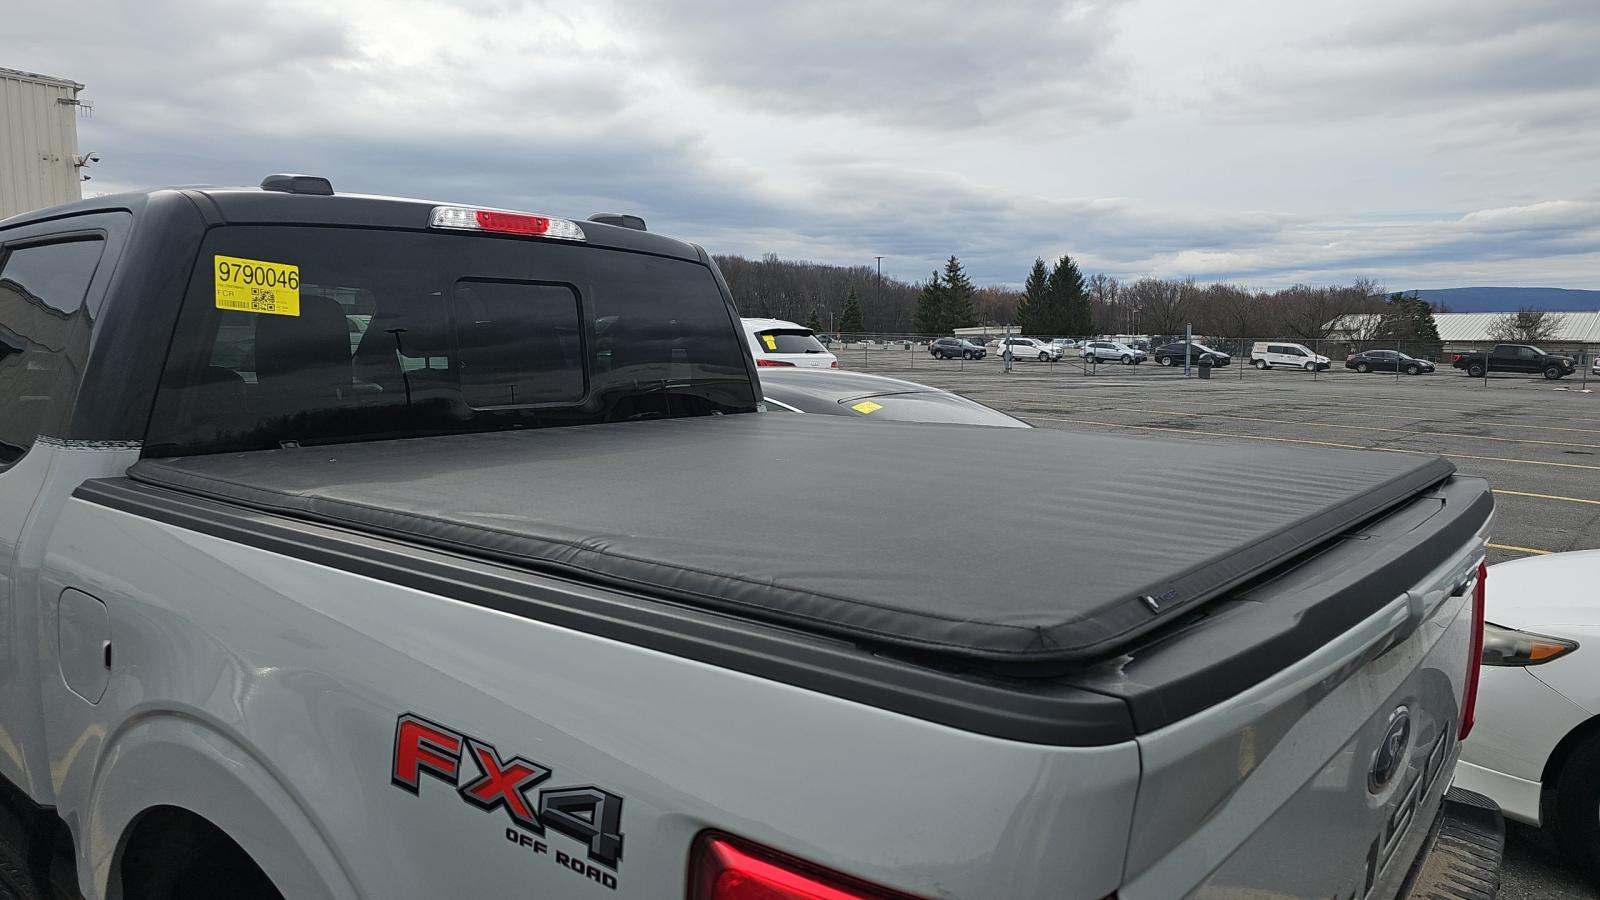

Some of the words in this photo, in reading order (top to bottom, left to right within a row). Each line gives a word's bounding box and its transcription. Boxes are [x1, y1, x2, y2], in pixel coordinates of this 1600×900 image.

[219, 261, 299, 290] 9790046
[391, 712, 624, 872] FX4
[1333, 718, 1451, 900] 150
[506, 827, 549, 855] OFF
[555, 849, 618, 890] ROAD
